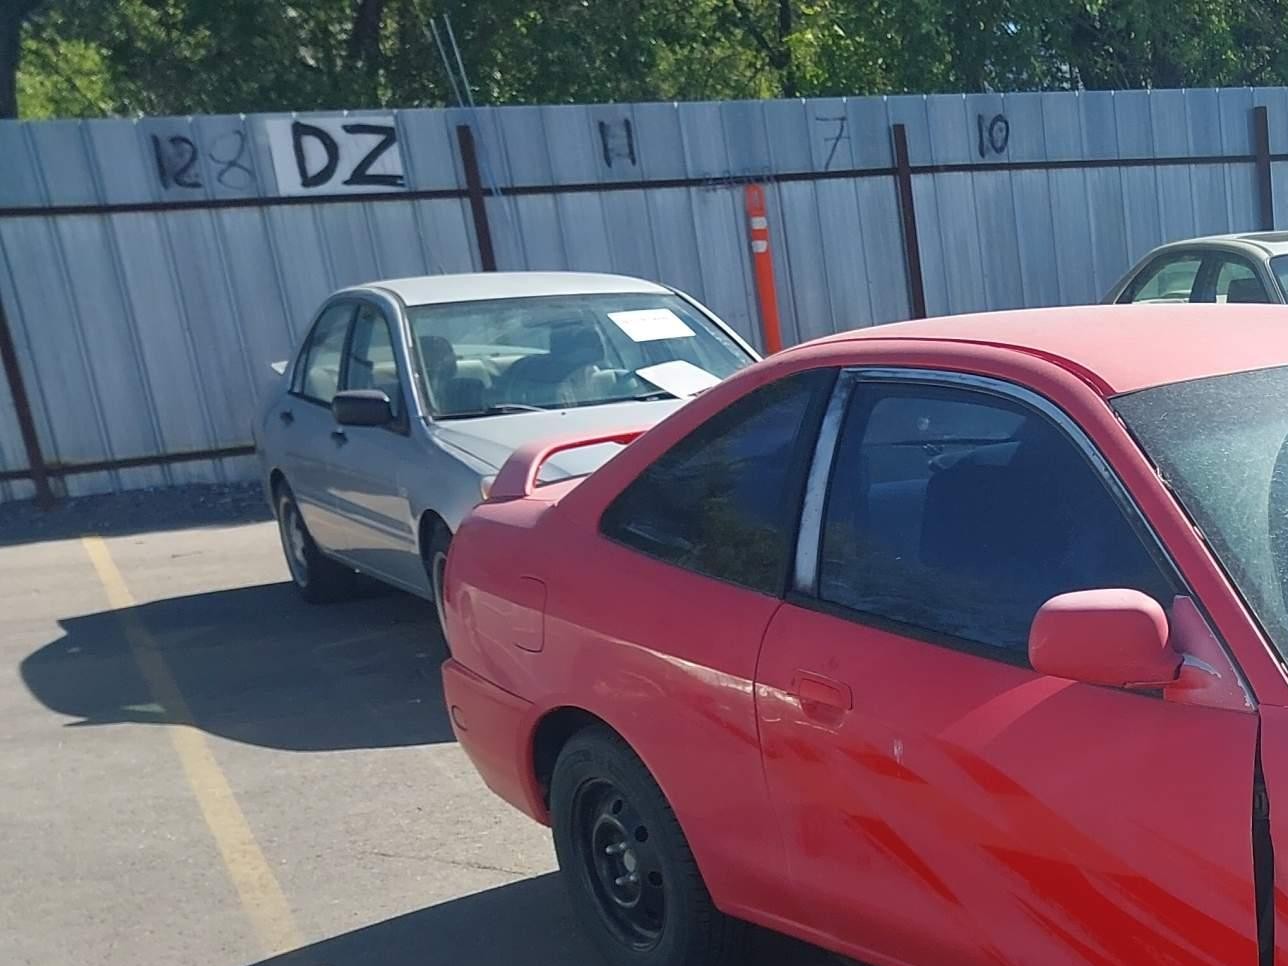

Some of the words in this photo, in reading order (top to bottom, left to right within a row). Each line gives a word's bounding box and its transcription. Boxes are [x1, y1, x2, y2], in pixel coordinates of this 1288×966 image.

[291, 121, 405, 188] DZ
[815, 115, 850, 170] 7
[976, 113, 1010, 159] 10
